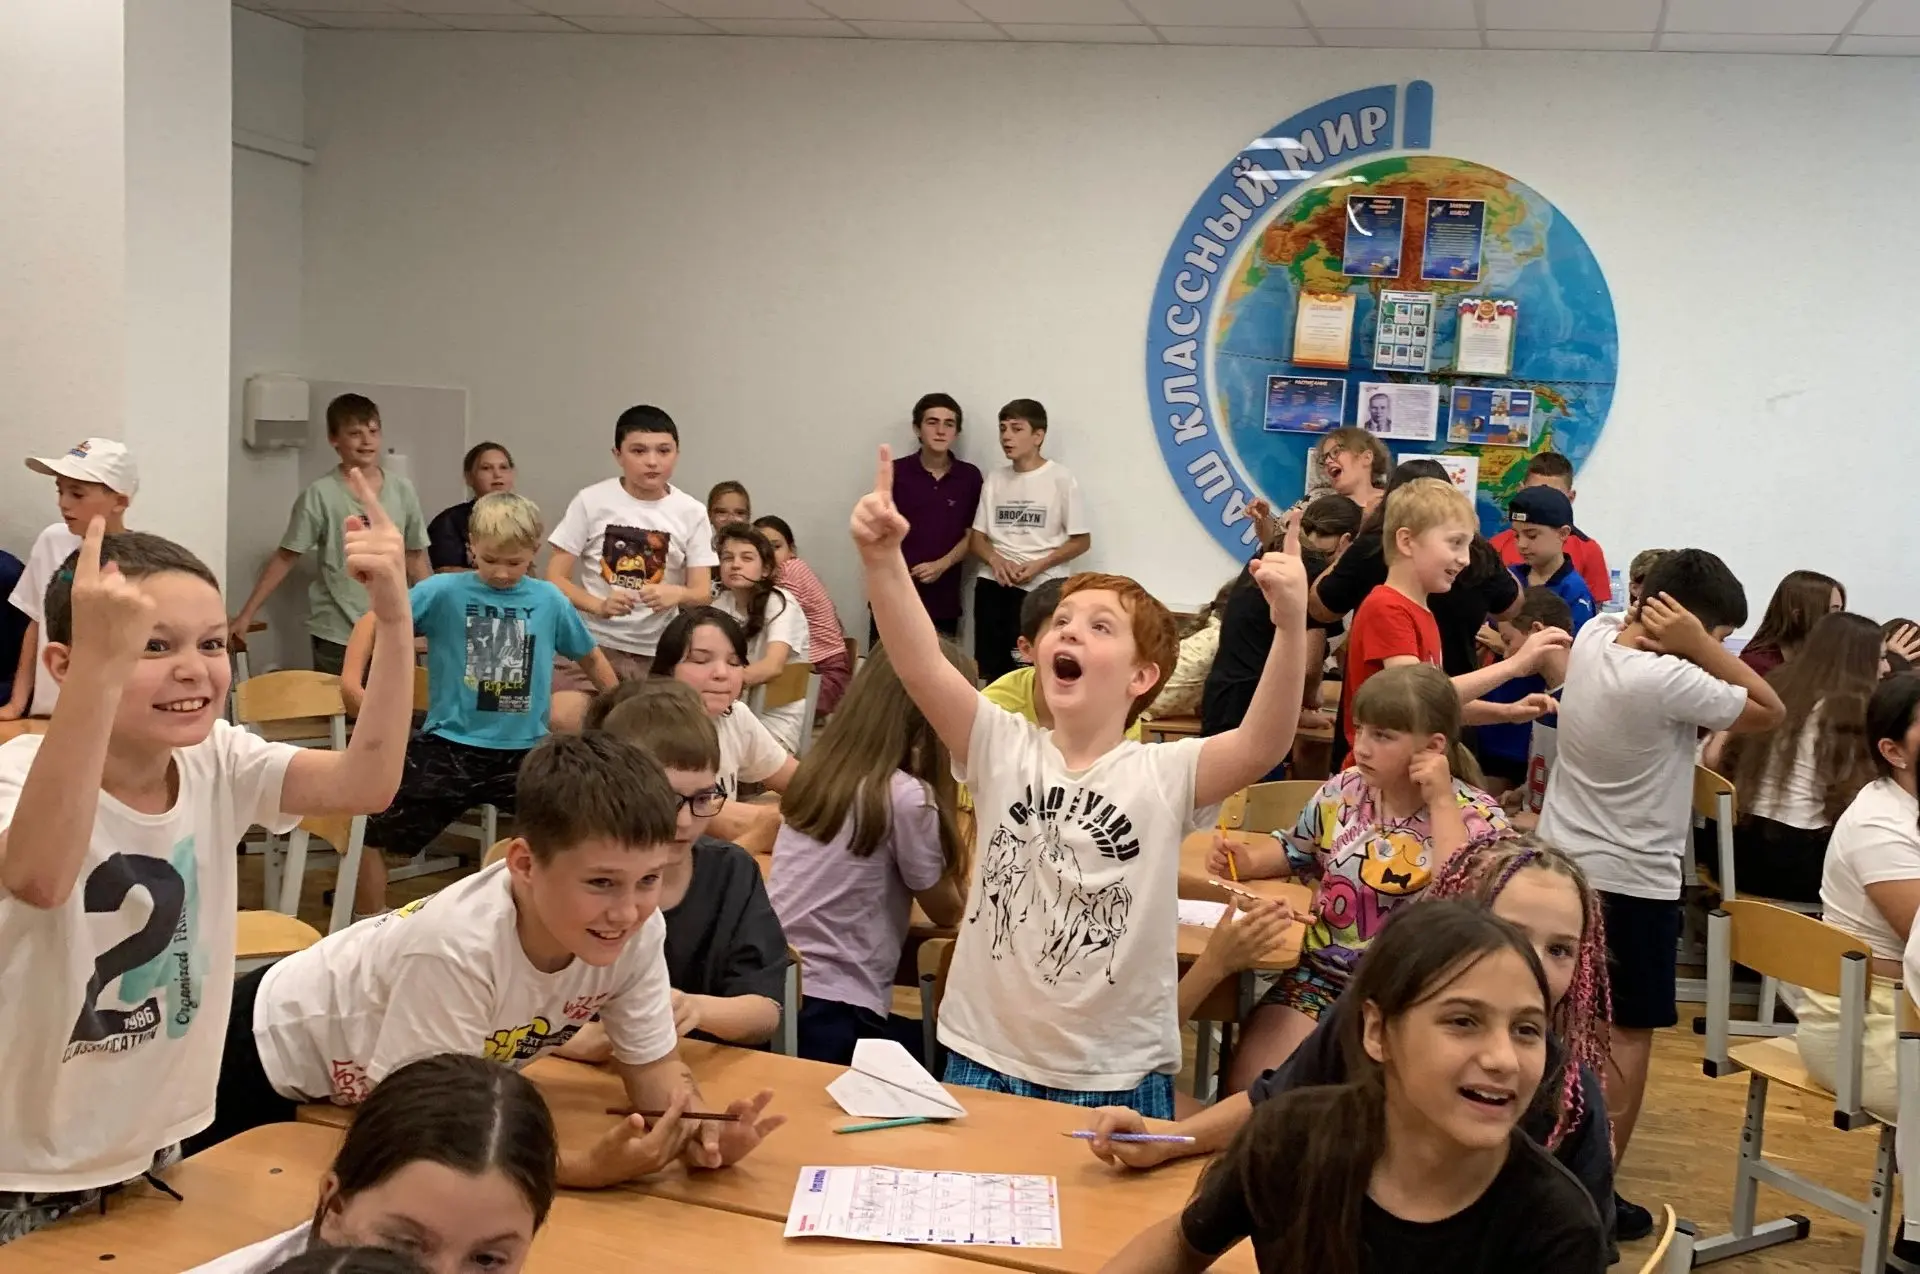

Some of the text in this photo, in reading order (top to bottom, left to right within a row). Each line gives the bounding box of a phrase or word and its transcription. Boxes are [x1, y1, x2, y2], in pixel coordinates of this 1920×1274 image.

[1162, 106, 1388, 551] АШ КЛАССНЫЙ МИР
[69, 852, 186, 1046] 2
[173, 951, 199, 1025] Organized
[123, 1006, 155, 1030] 1986
